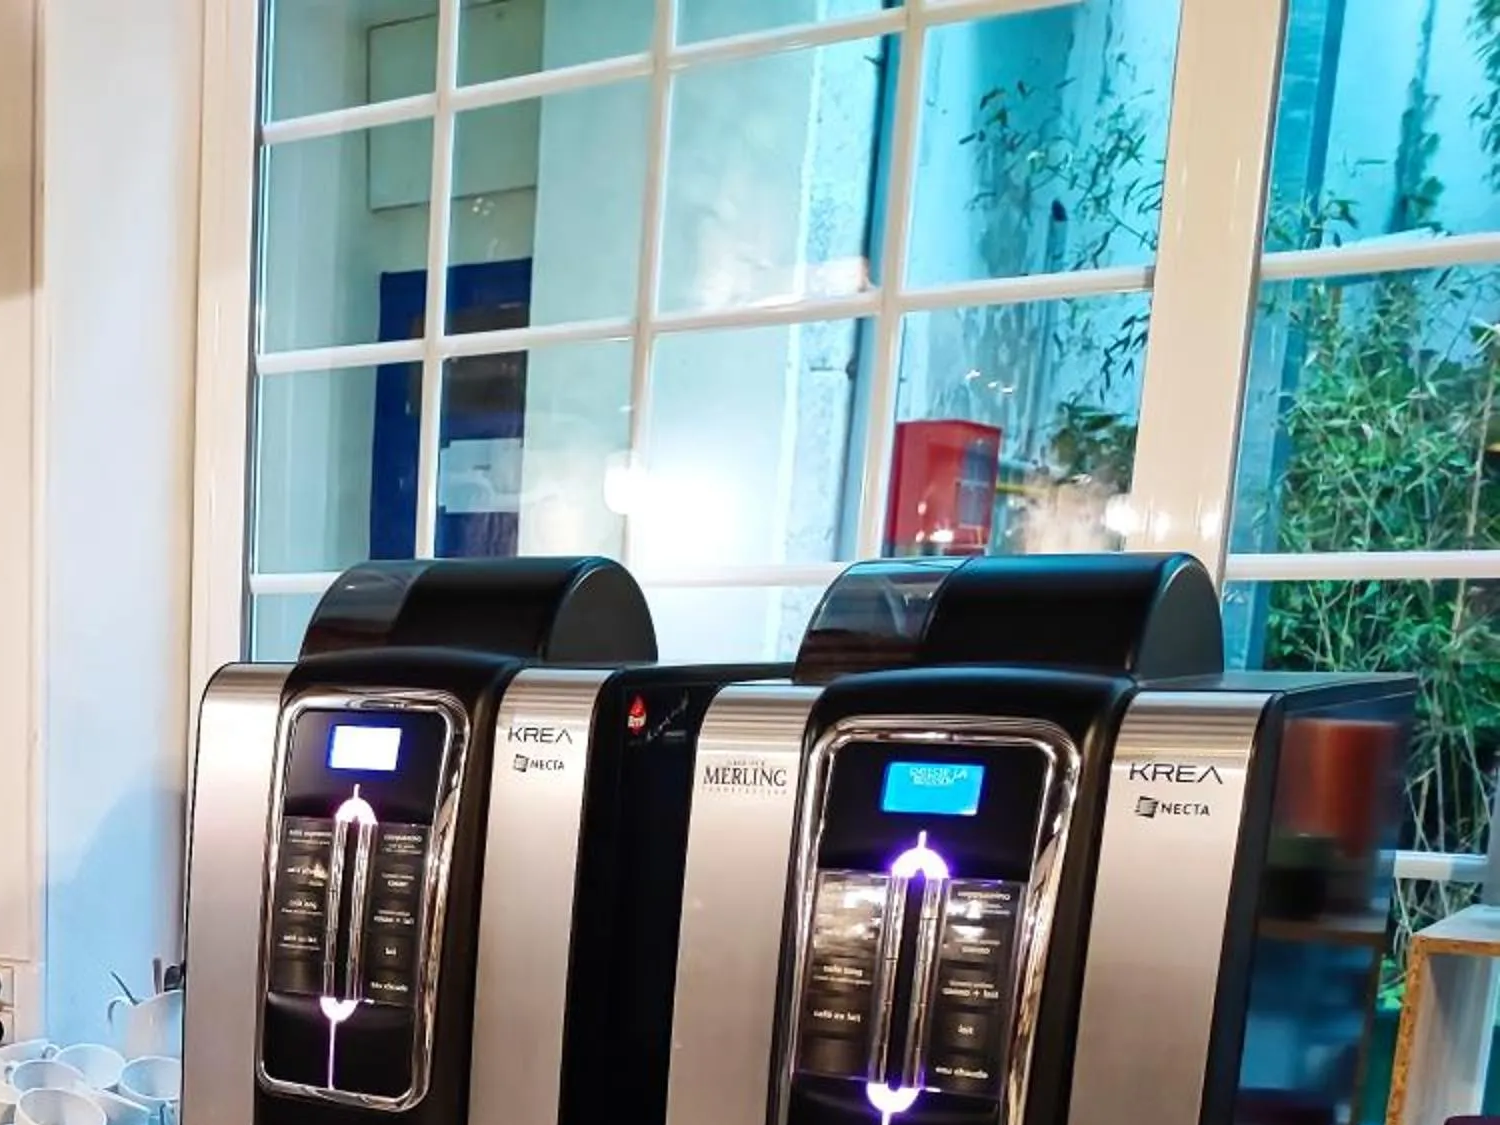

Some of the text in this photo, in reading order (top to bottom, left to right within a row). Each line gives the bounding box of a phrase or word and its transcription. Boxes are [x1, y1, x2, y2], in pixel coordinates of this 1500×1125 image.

[507, 725, 573, 744] KREA
[529, 758, 565, 771] NECTA
[1129, 762, 1224, 785] KREA
[703, 765, 787, 787] MERLING
[1160, 802, 1211, 817] NECTA
